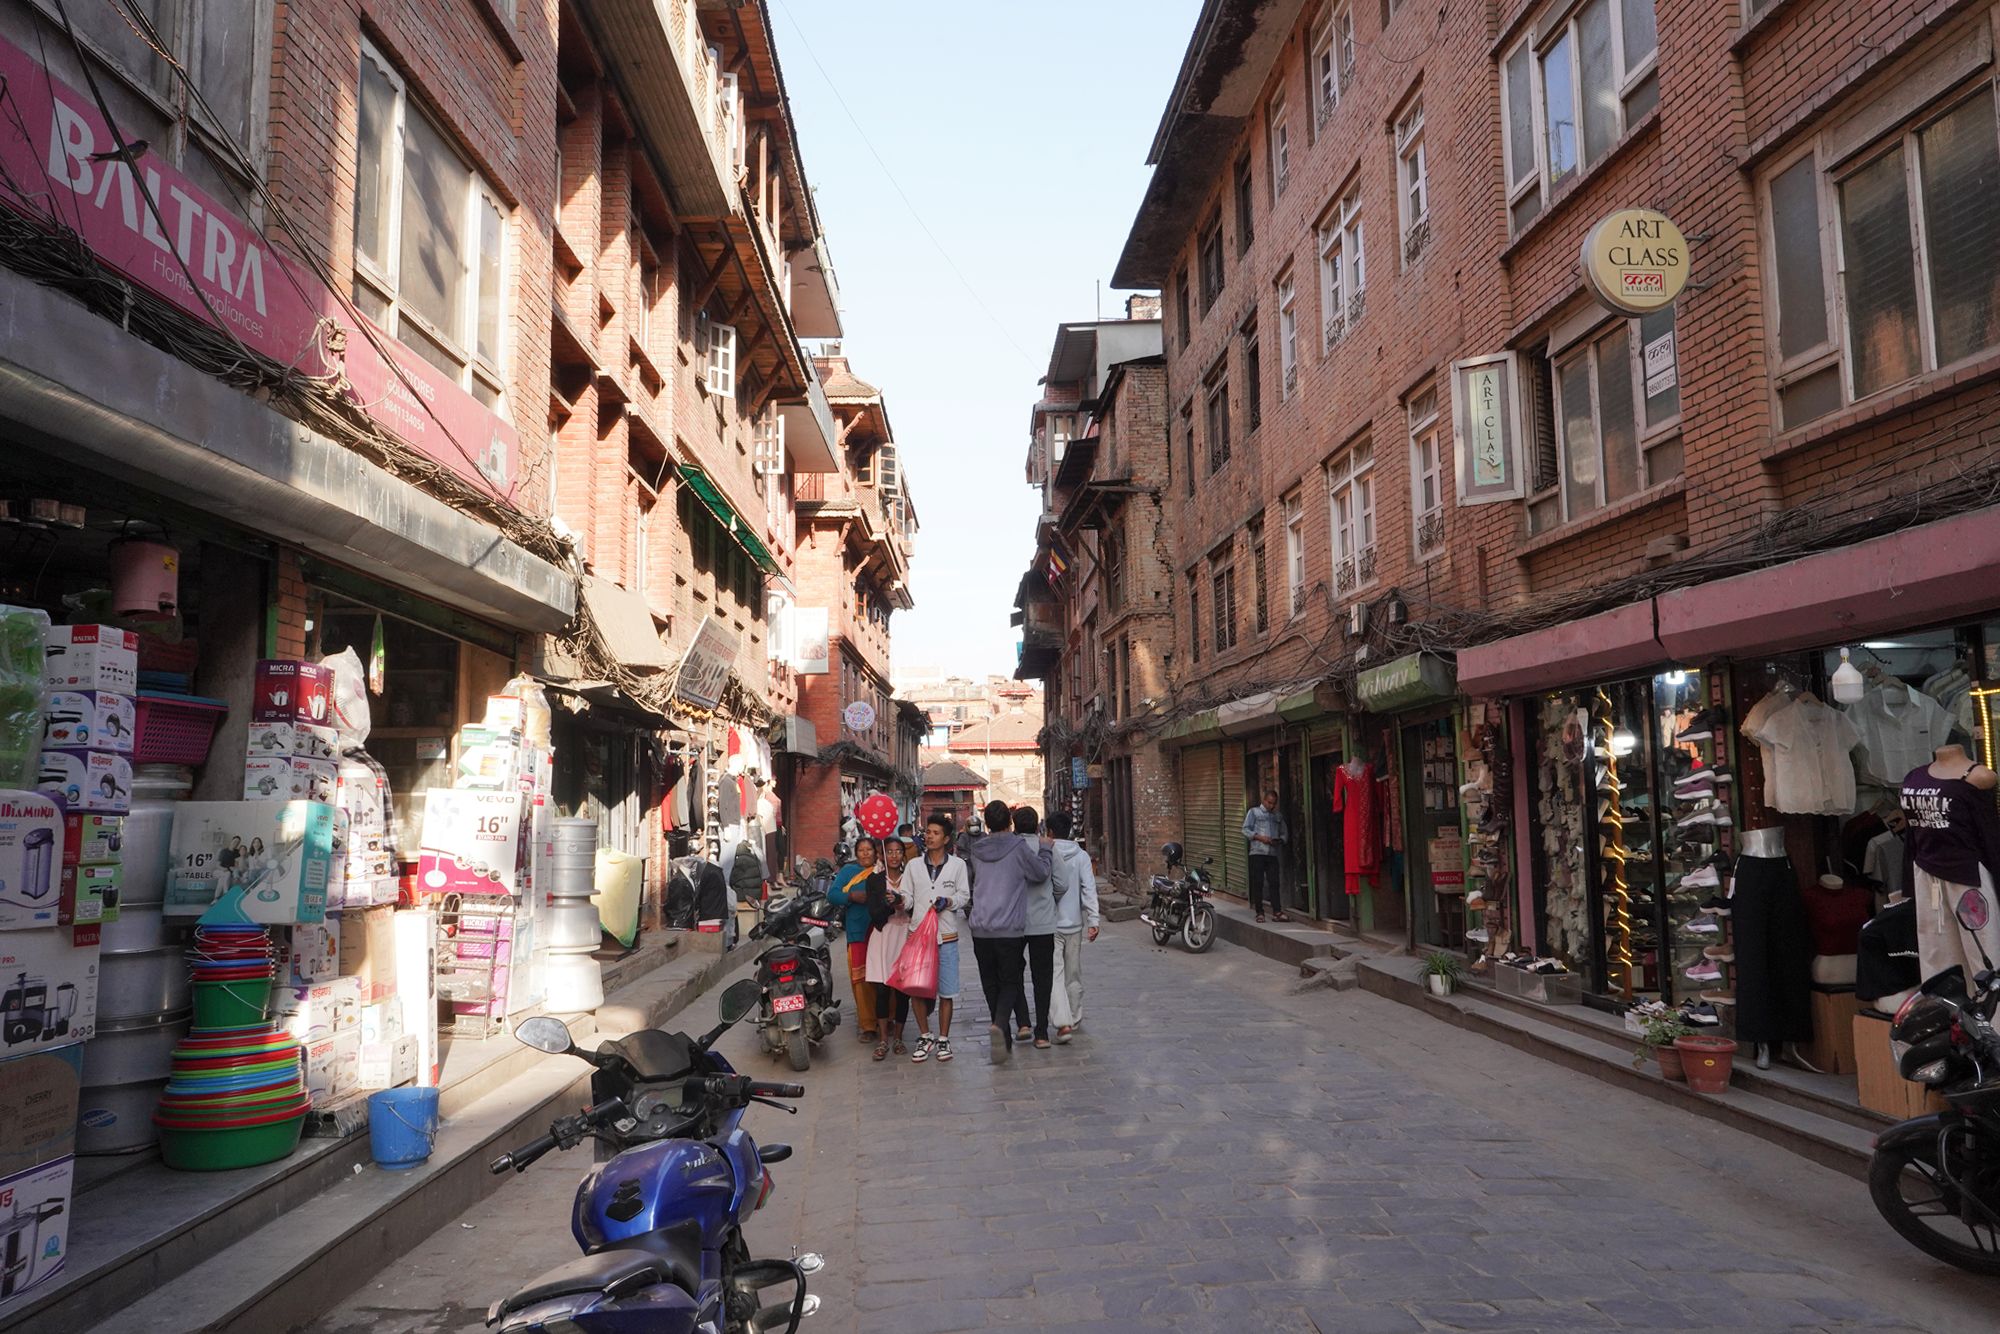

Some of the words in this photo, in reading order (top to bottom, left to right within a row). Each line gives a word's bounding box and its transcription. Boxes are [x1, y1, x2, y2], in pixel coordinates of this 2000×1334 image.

[48, 96, 267, 318] BALTRA
[1619, 219, 1665, 239] ART
[1608, 246, 1680, 267] CLASS
[152, 250, 195, 294] Home
[198, 284, 265, 339] appliances
[1624, 284, 1662, 292] studio
[1482, 374, 1494, 410] ART
[269, 664, 295, 672] MICRA
[300, 665, 317, 675] MICRA
[475, 795, 515, 804] VEVO
[477, 815, 509, 833] 16"
[184, 871, 211, 879] TABLE
